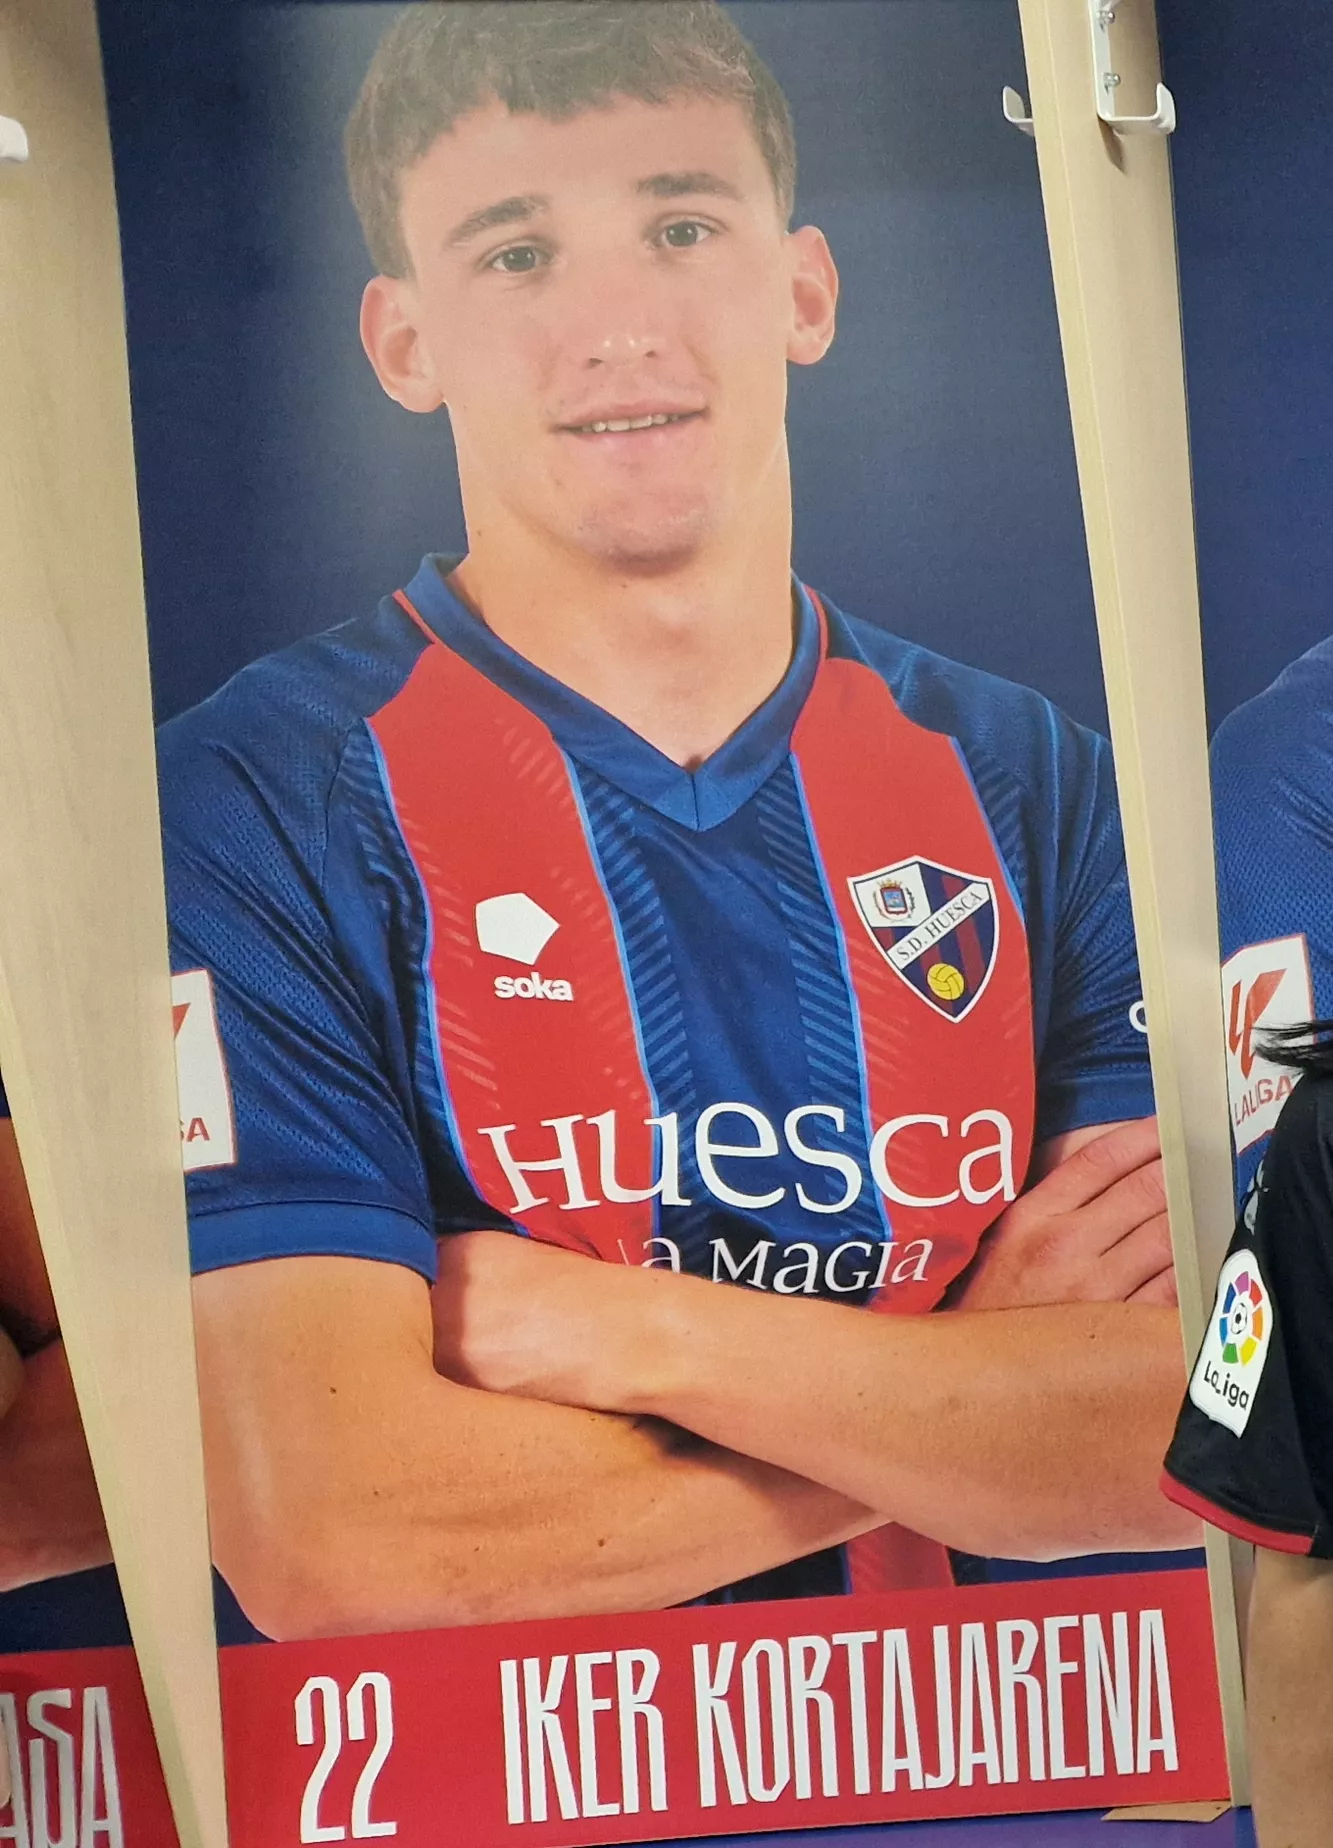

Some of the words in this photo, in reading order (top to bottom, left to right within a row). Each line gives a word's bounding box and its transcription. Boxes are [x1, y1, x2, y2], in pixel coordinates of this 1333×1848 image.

[924, 891, 983, 939] HUESCA
[493, 971, 574, 1002] soka
[1234, 1075, 1297, 1127] LALIGA
[477, 1100, 1017, 1214] Huesca
[295, 1671, 398, 1844] 22
[499, 1646, 672, 1826] IKER
[691, 1607, 1180, 1809] KORTAJARENA
